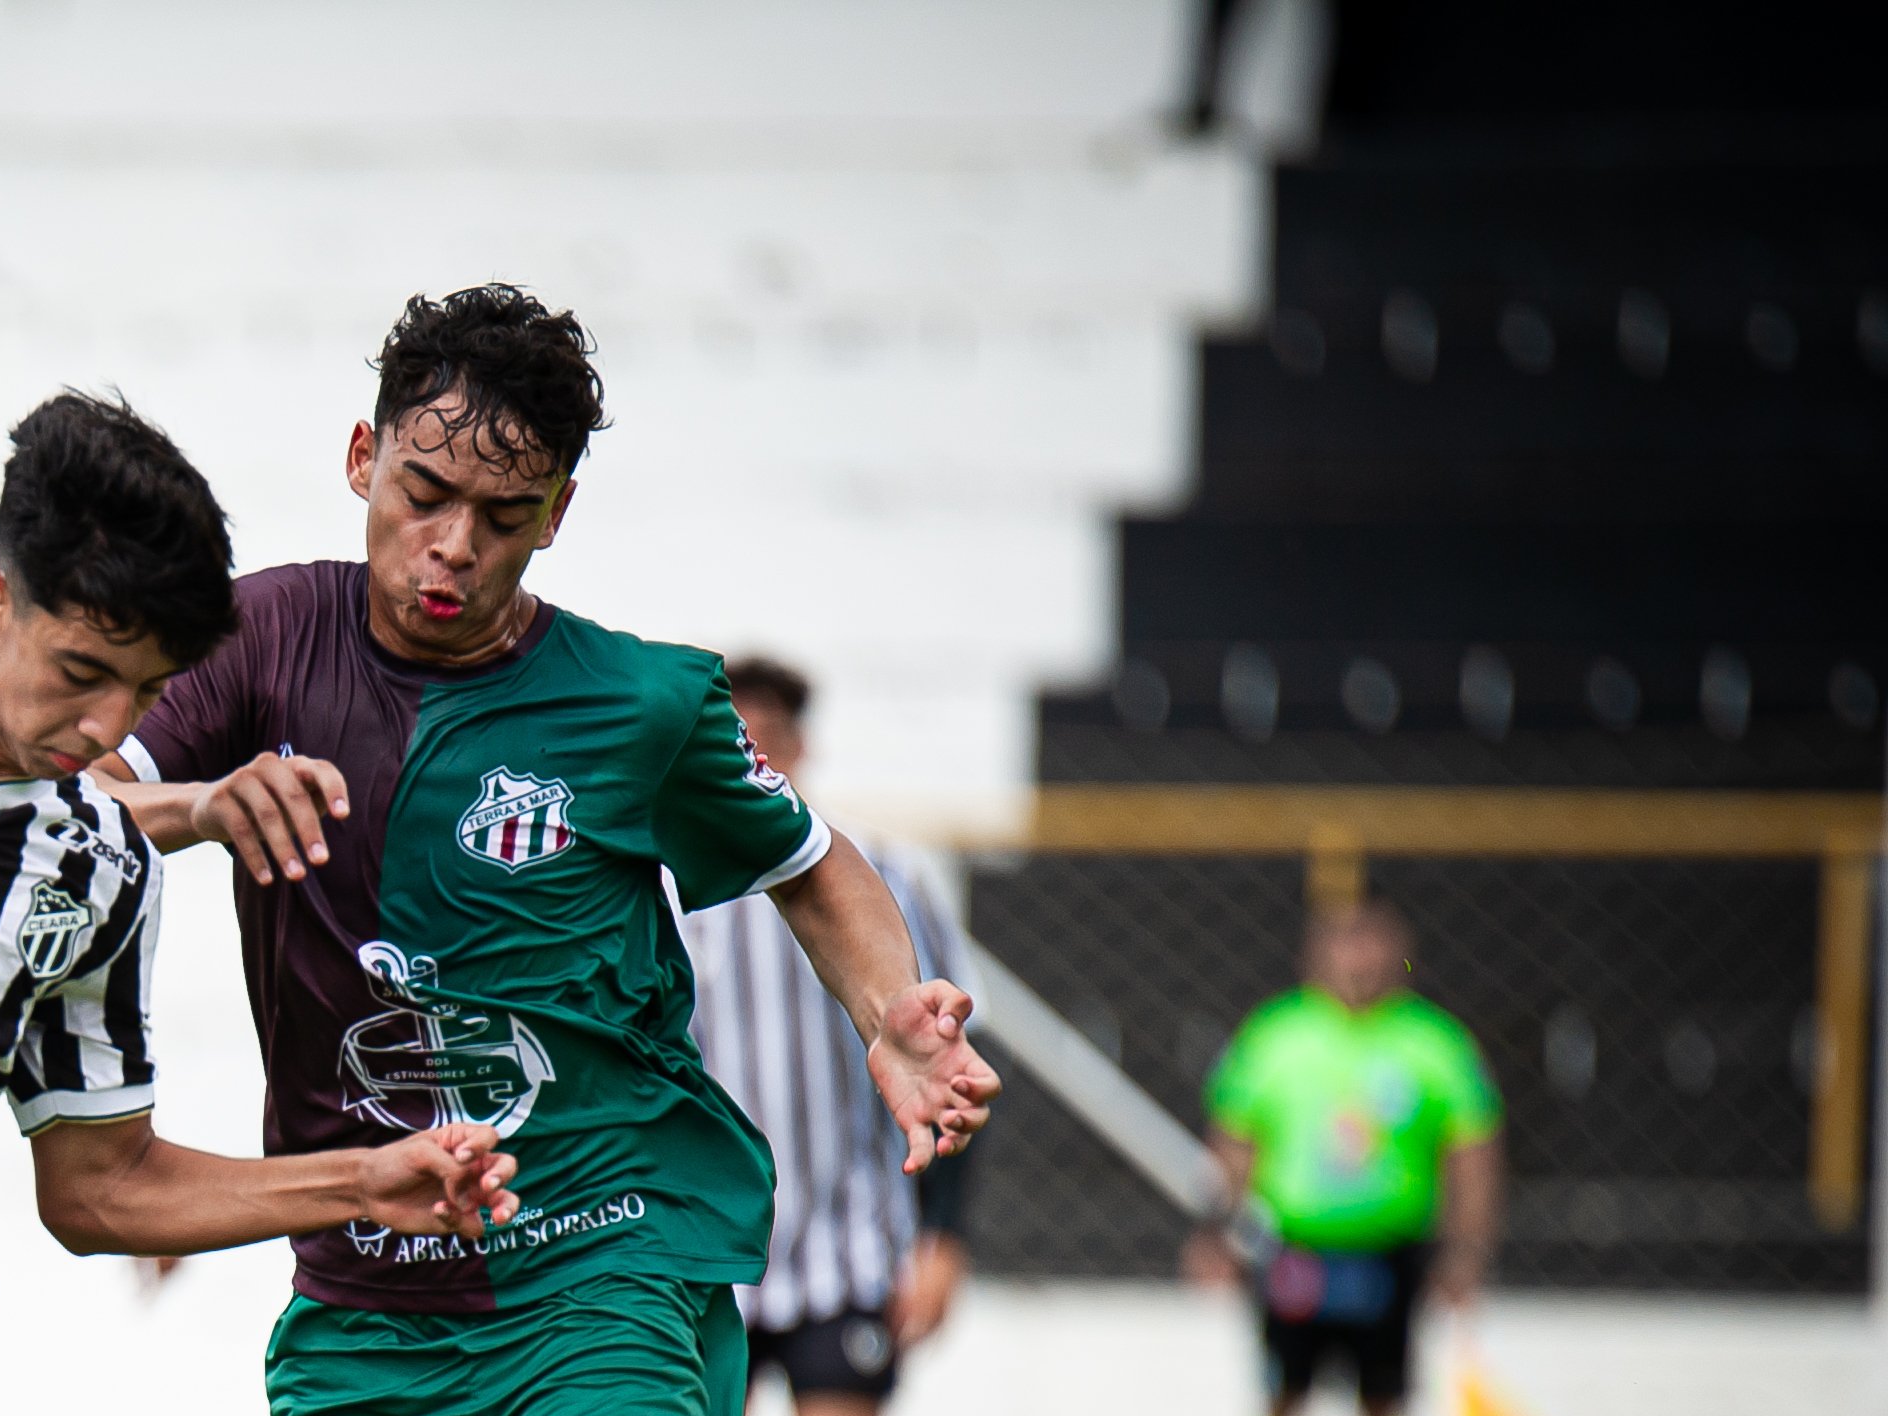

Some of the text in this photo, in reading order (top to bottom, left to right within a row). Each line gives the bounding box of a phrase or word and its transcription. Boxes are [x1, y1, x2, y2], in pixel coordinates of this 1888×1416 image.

[466, 787, 560, 829] TERRA & MAR
[384, 1069, 467, 1081] ESTIVADORES
[425, 1057, 451, 1067] DOS
[394, 1233, 468, 1263] ABRA
[473, 1229, 517, 1255] UM
[525, 1192, 645, 1248] SORRISO
